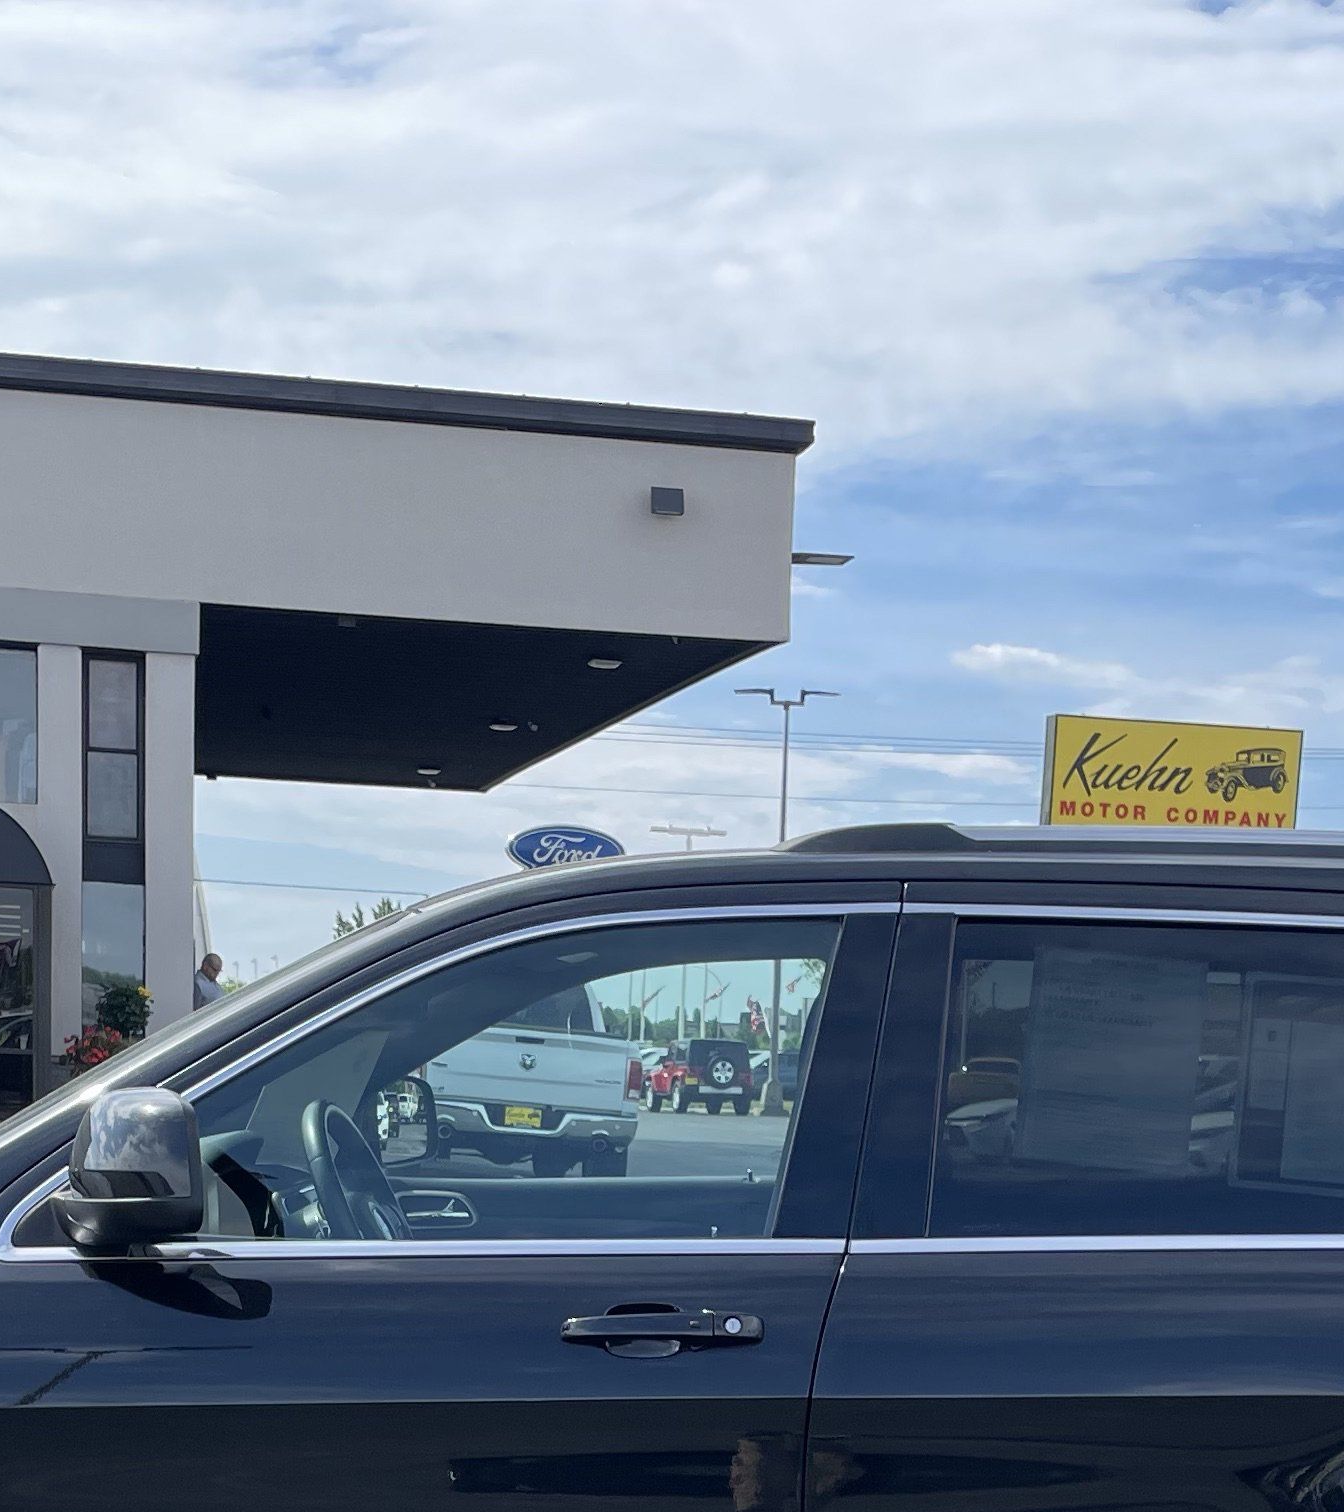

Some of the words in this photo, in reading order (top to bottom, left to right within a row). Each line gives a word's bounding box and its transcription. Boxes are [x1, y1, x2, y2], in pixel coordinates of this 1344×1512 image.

[1062, 732, 1194, 797] Kuehn
[1059, 800, 1146, 821] MOTOR
[1166, 807, 1287, 828] COMPANY
[533, 834, 603, 864] Ford
